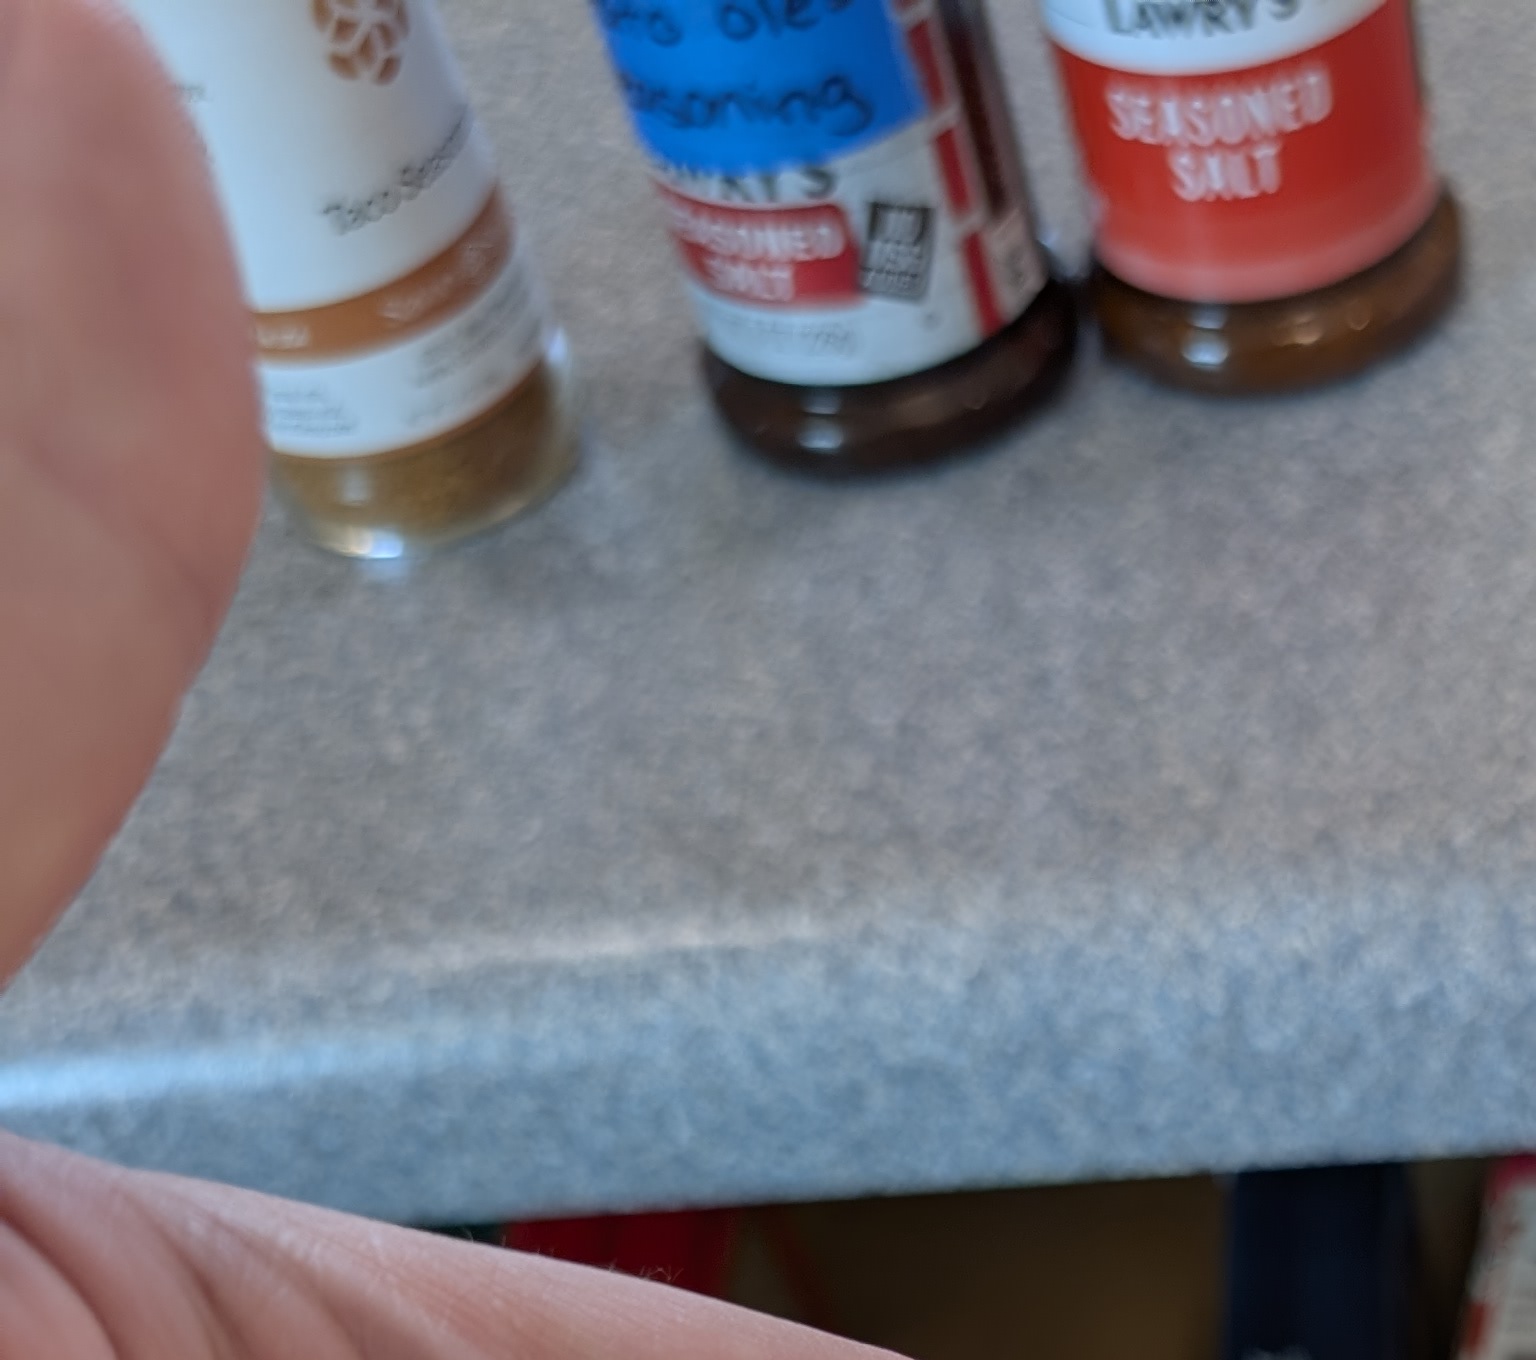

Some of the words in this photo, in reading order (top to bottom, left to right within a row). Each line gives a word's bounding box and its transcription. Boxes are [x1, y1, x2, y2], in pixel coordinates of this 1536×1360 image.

[1103, 0, 1299, 38] LAWRYS
[1105, 64, 1333, 147] SEASONED
[1167, 140, 1283, 202] SALT
